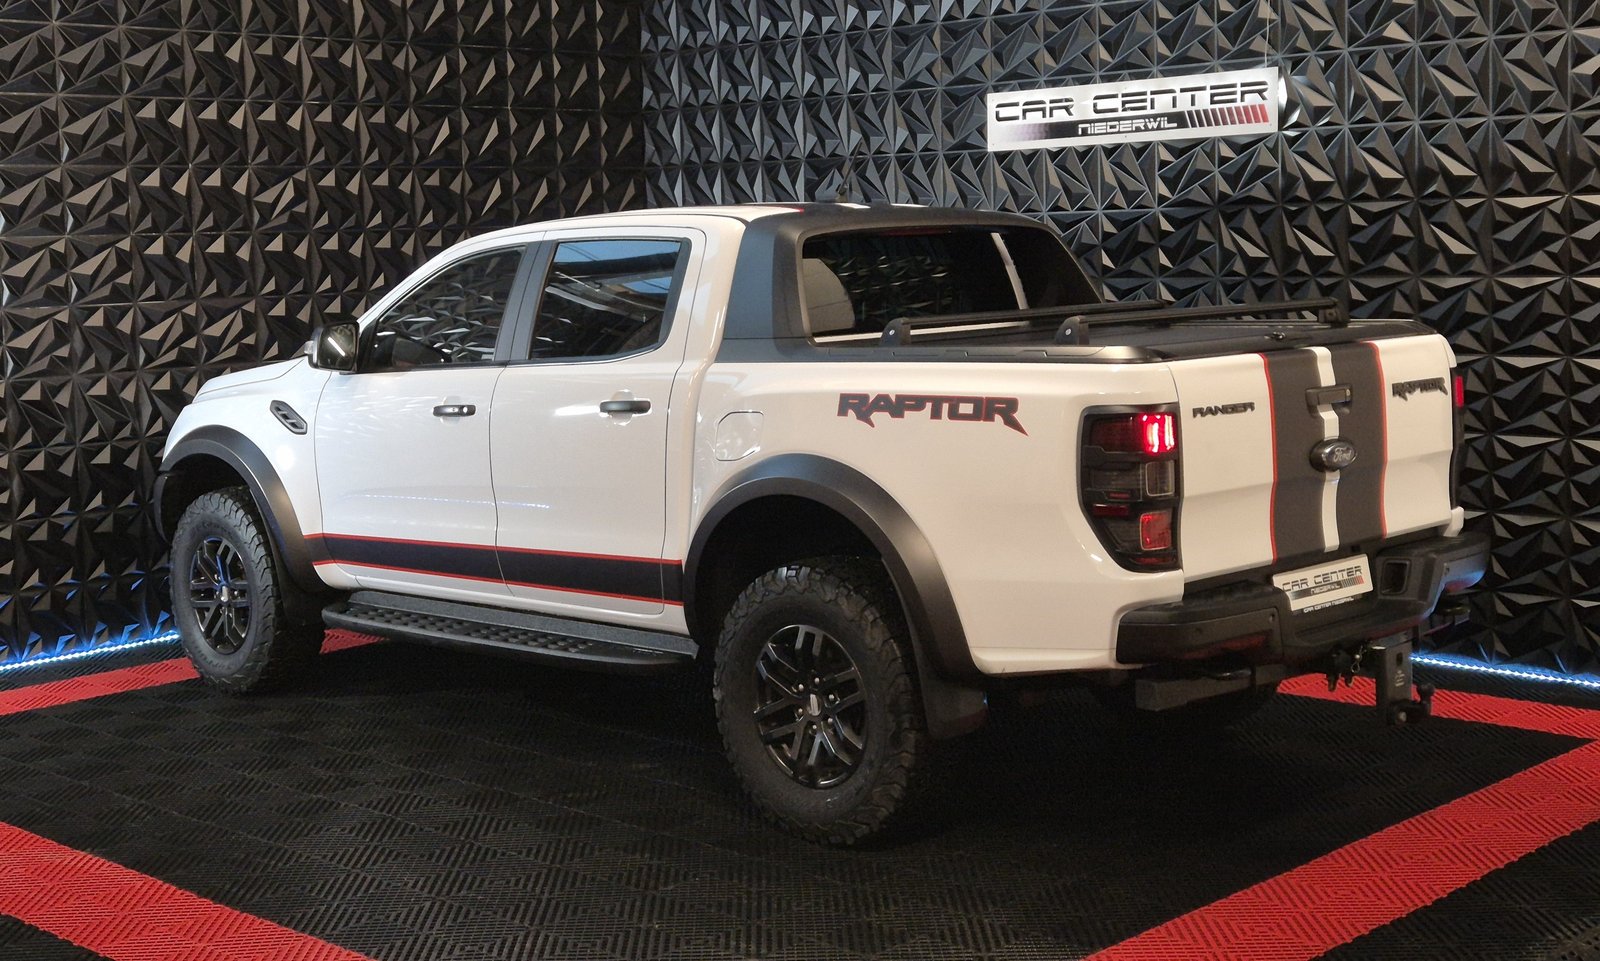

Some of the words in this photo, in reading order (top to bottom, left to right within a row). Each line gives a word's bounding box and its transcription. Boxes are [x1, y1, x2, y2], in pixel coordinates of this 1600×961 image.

[995, 98, 1074, 122] CAR
[1093, 80, 1269, 114] CENTER
[1078, 117, 1177, 135] NIEDERWIL
[1392, 377, 1448, 400] RAPTOR
[837, 393, 1029, 436] RAPTOR
[1192, 402, 1255, 418] RANGER
[1333, 447, 1353, 462] Ford
[1282, 578, 1309, 592] CAR
[1313, 565, 1362, 585] CENTER
